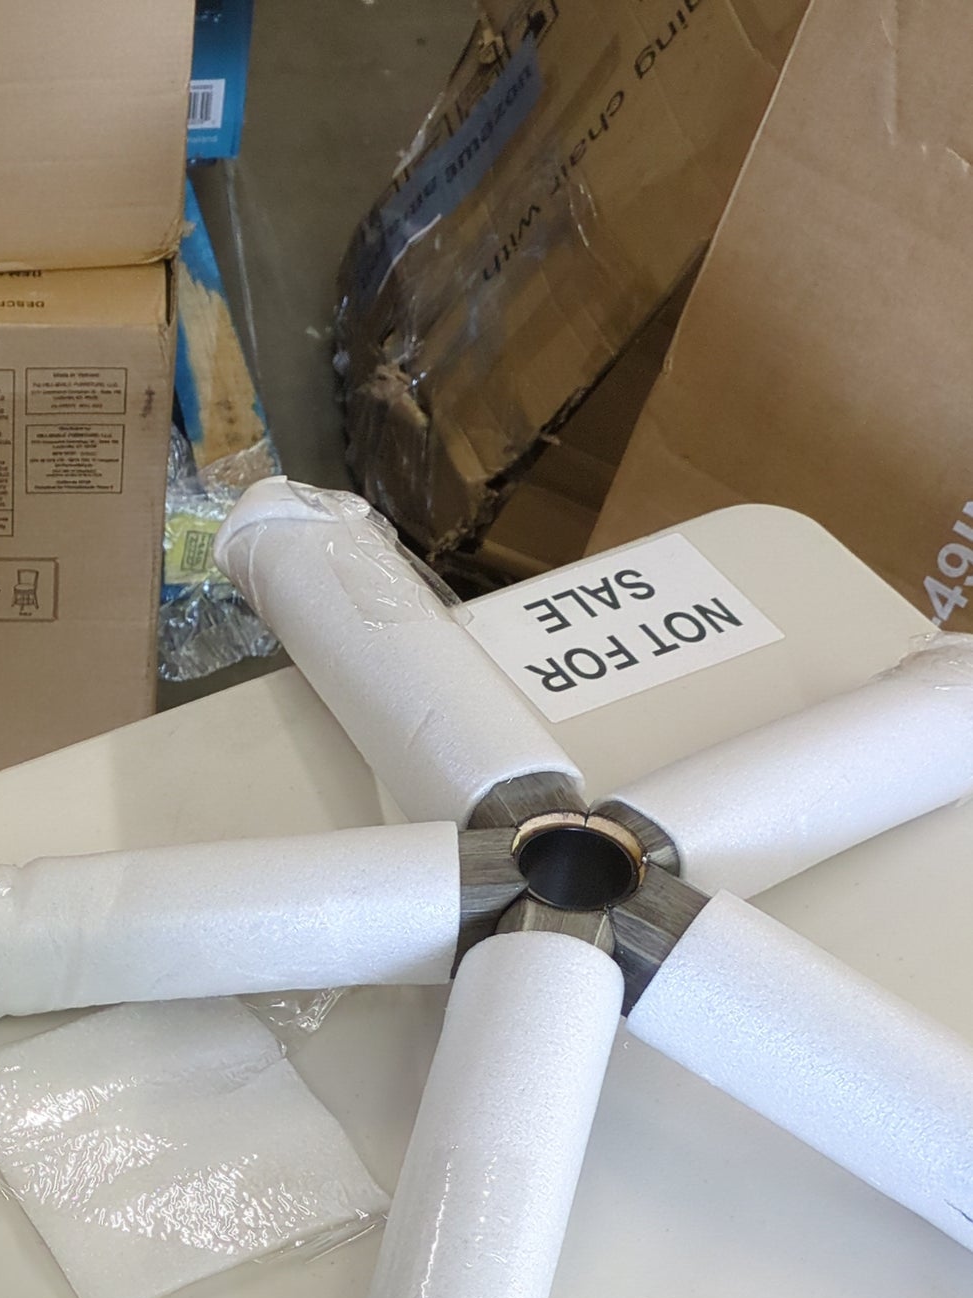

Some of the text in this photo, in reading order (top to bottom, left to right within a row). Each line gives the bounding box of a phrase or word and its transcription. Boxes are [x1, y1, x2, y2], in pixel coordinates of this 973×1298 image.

[550, 91, 624, 195] chair
[523, 569, 656, 634] SALE
[523, 597, 743, 692] NOT FOR
